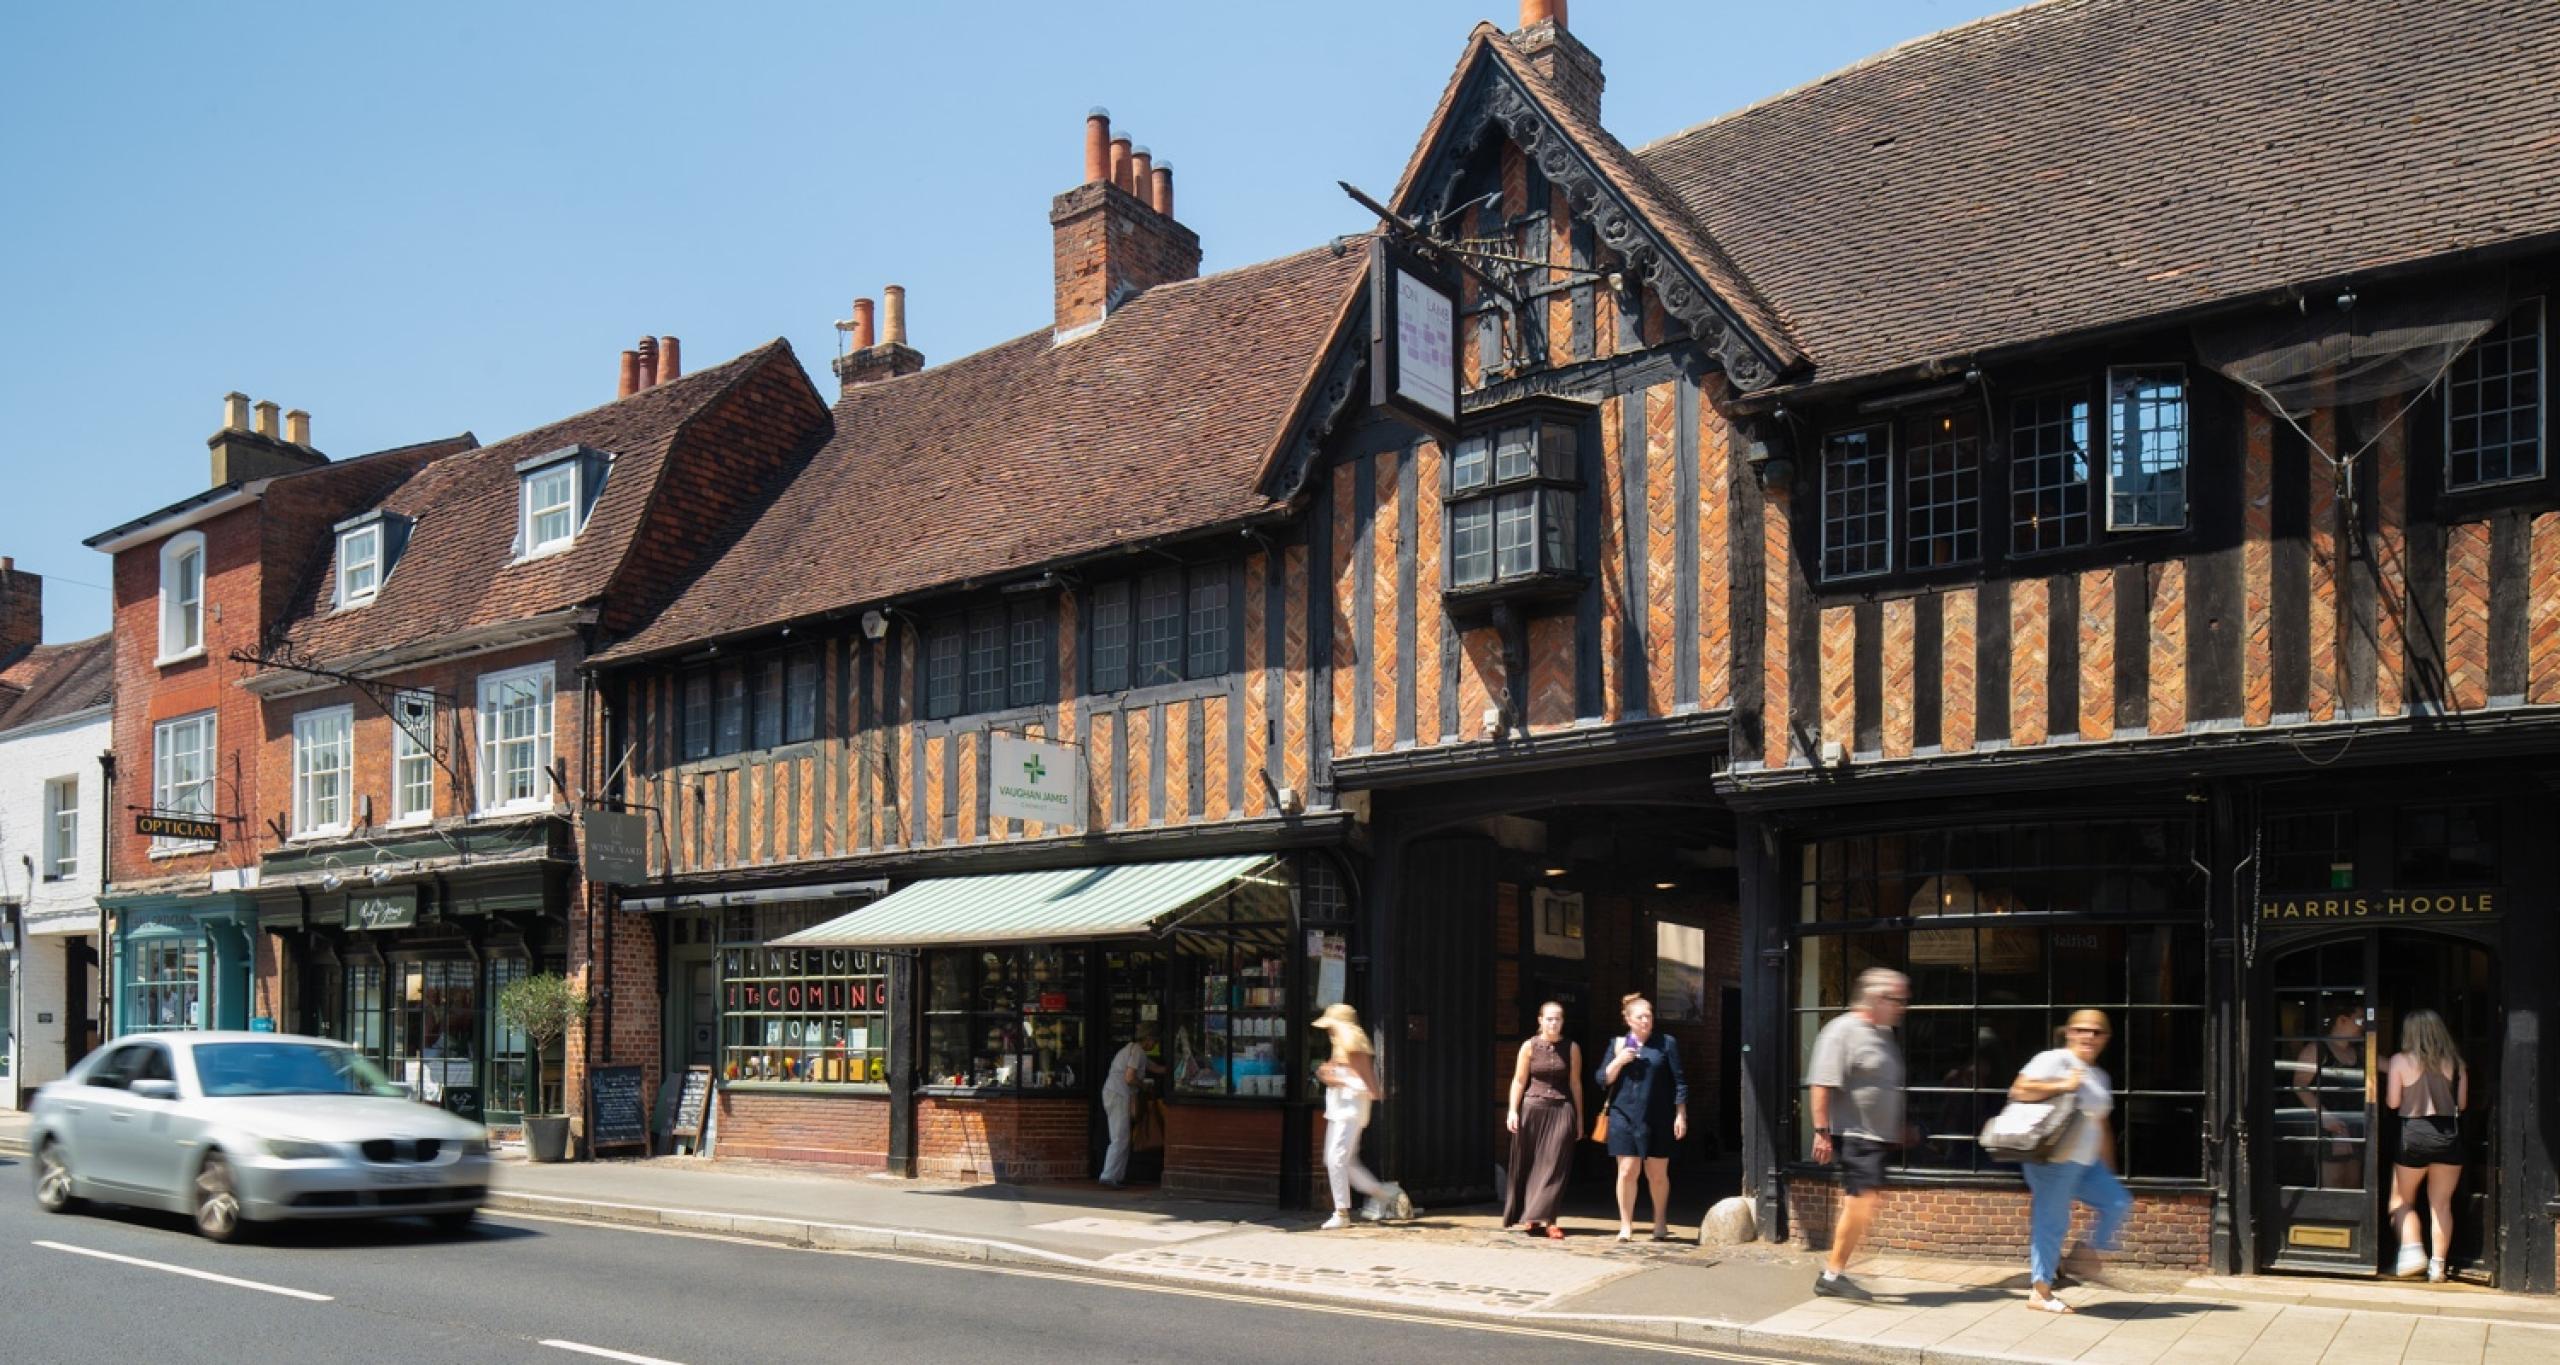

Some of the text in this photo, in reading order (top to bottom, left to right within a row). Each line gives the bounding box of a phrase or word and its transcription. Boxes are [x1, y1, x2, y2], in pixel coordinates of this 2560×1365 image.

[999, 786, 1068, 804] VAUGHAN JAMES
[140, 819, 216, 837] OPTICIAN
[2262, 900, 2369, 919] HARRIS
[2388, 895, 2493, 914] HOOLE
[767, 984, 885, 1008] COMING
